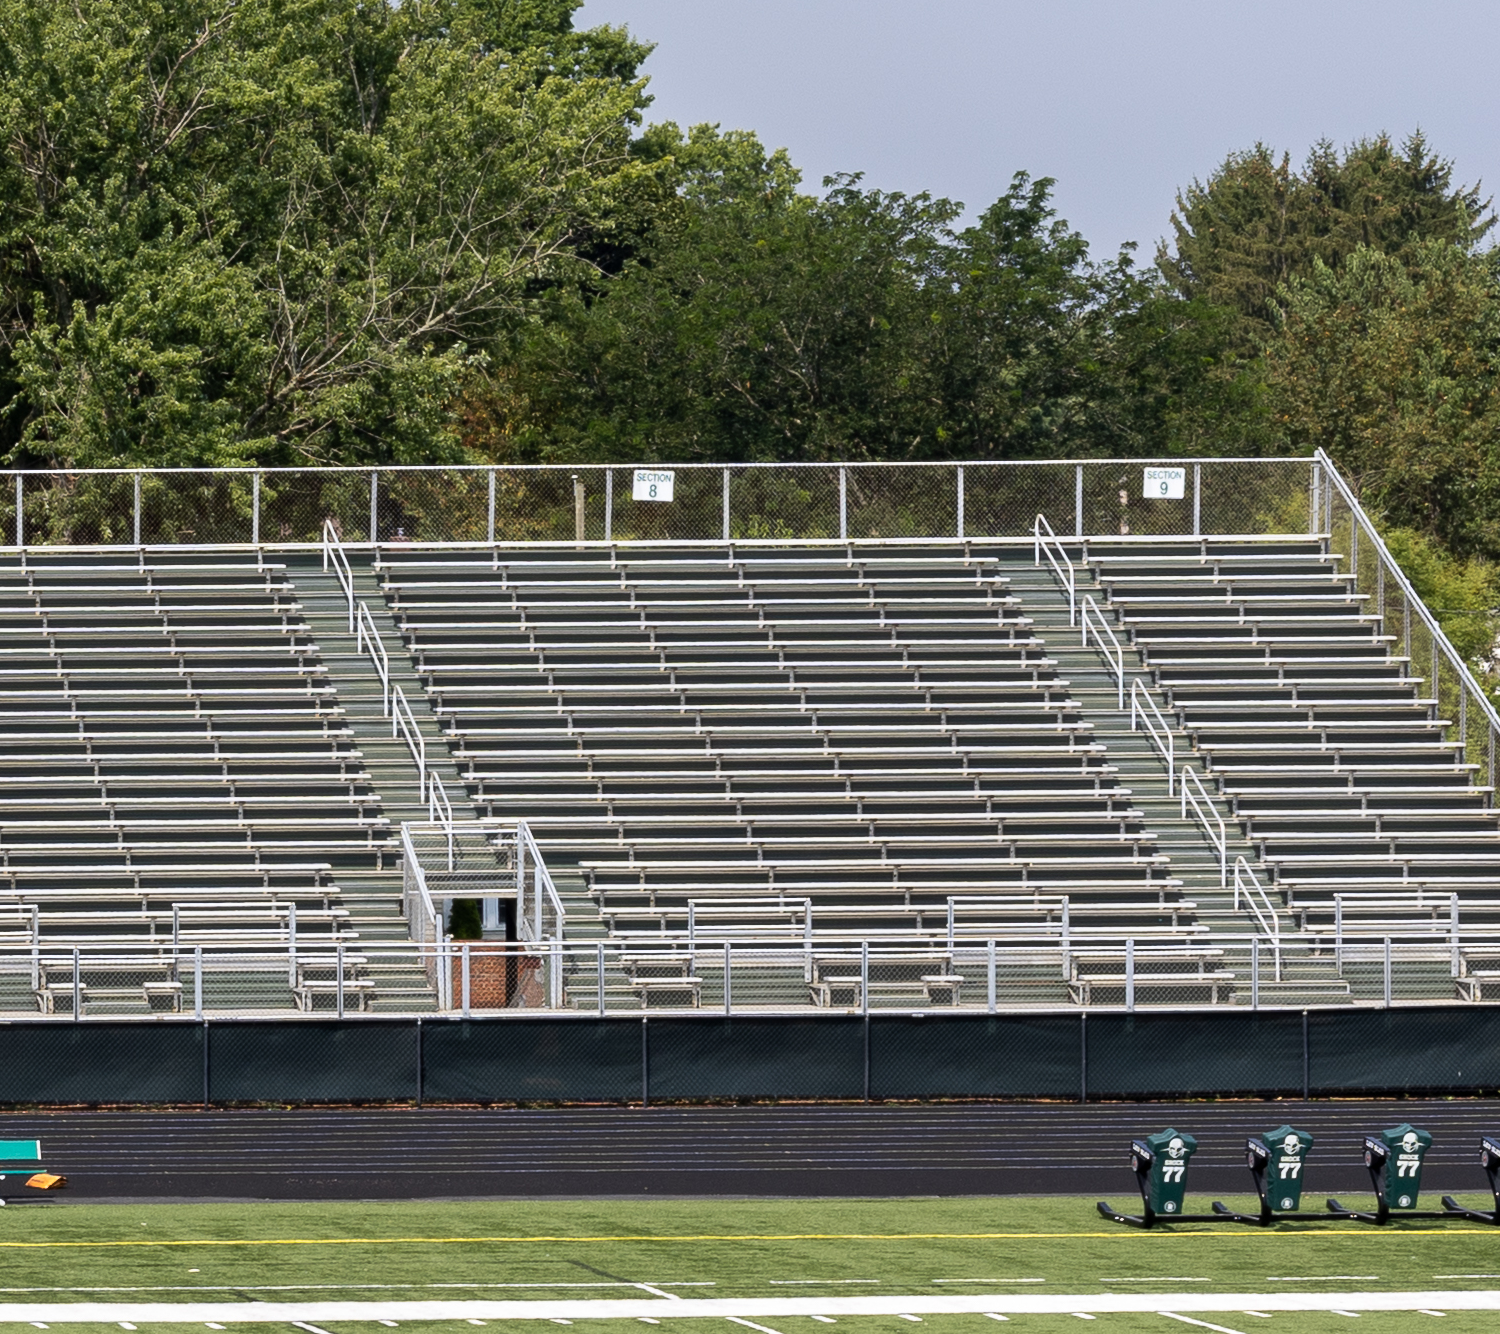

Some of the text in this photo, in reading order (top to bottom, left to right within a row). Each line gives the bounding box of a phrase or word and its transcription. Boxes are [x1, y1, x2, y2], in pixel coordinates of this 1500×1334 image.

[636, 472, 672, 482] SECTION
[1147, 470, 1182, 480] SECTION
[649, 484, 657, 498] 8
[1160, 481, 1168, 495] 9
[1162, 1166, 1185, 1183] 77
[1278, 1162, 1301, 1179] 77
[1396, 1160, 1420, 1177] 77
